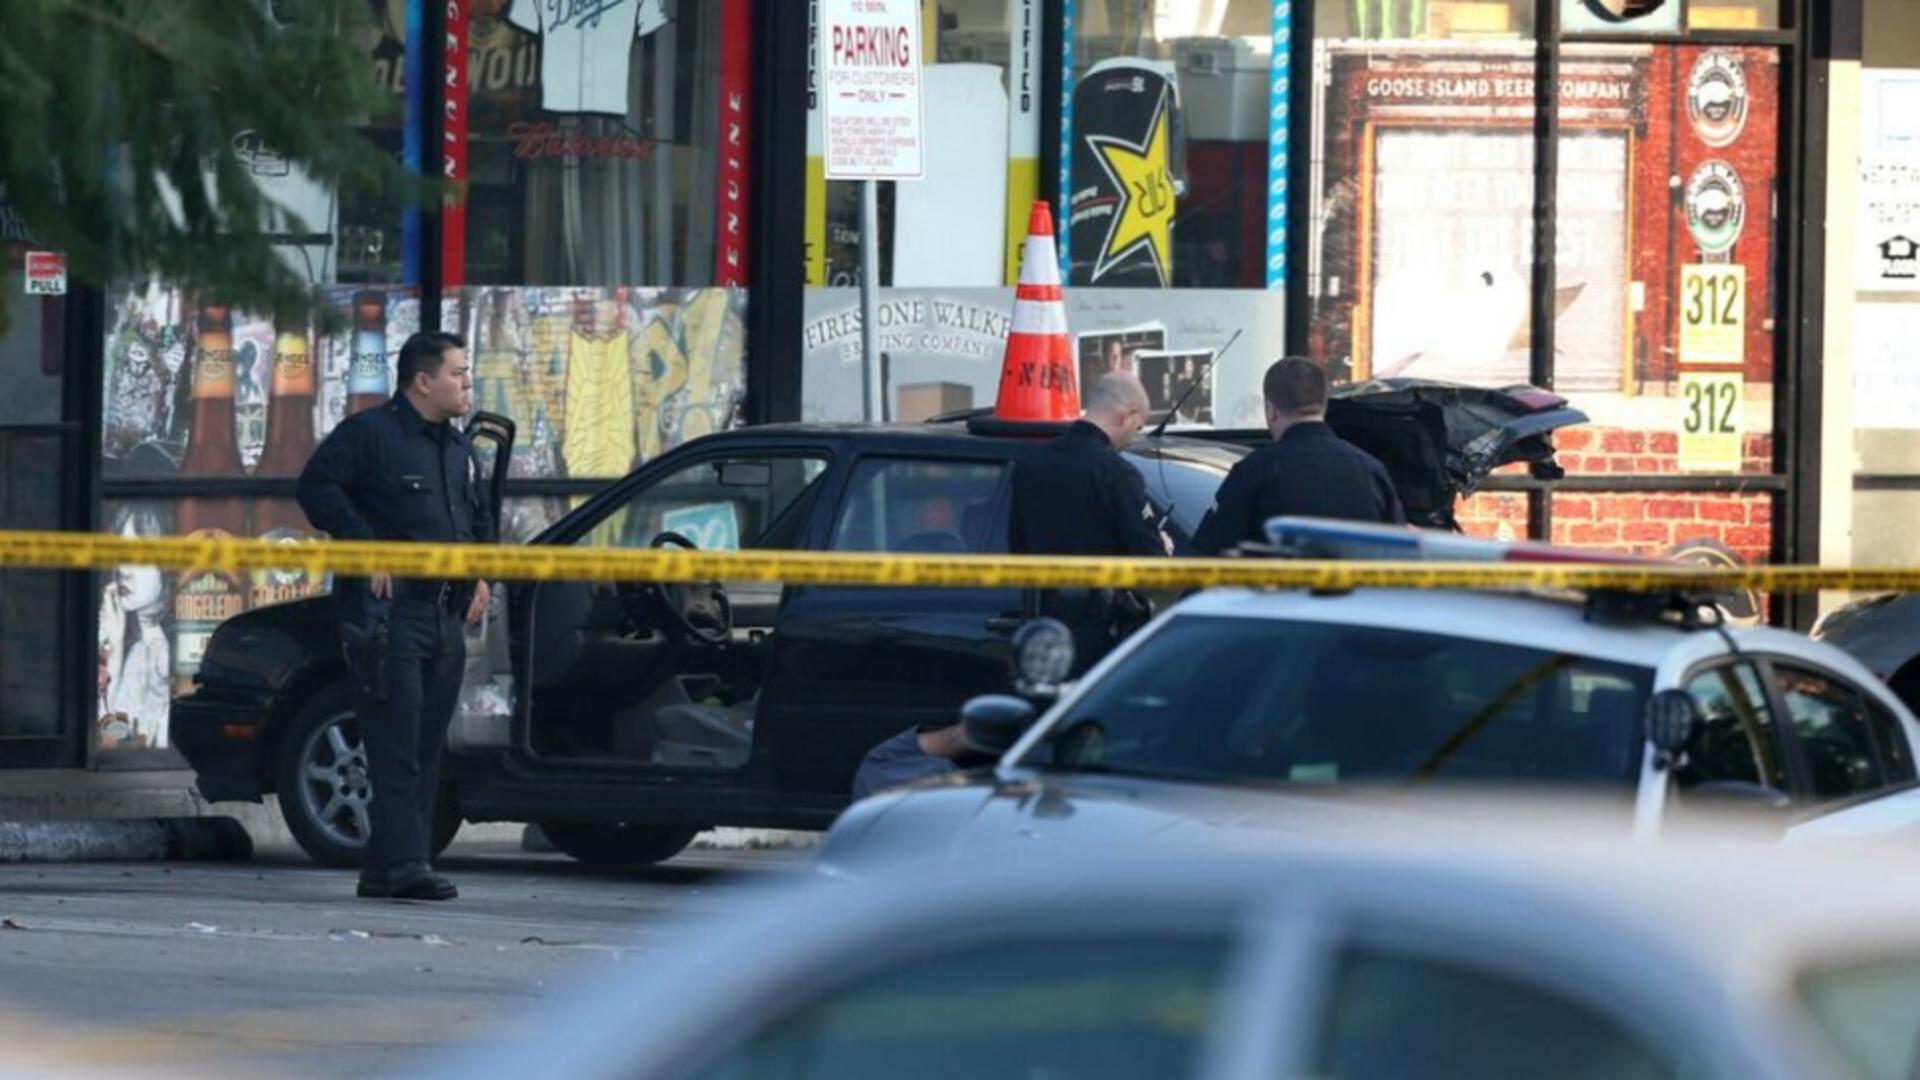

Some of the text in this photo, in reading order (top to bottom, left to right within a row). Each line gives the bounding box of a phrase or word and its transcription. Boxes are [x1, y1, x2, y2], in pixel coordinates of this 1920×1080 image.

[832, 25, 911, 68] PARKING
[829, 70, 915, 86] FOR CUSTOMERS
[1367, 78, 1424, 97] GOOSE
[1429, 79, 1489, 97] ISLAND
[1494, 79, 1534, 97] BEER
[858, 89, 886, 103] ONLY
[31, 279, 62, 292] PULL
[1686, 273, 1738, 325] 312
[803, 299, 1012, 349] FIRESONE WALKE
[351, 351, 387, 364] ANGEL
[843, 333, 994, 359] BRING COMPANY
[1684, 381, 1737, 433] 312
[175, 593, 243, 620] ANGELENO
